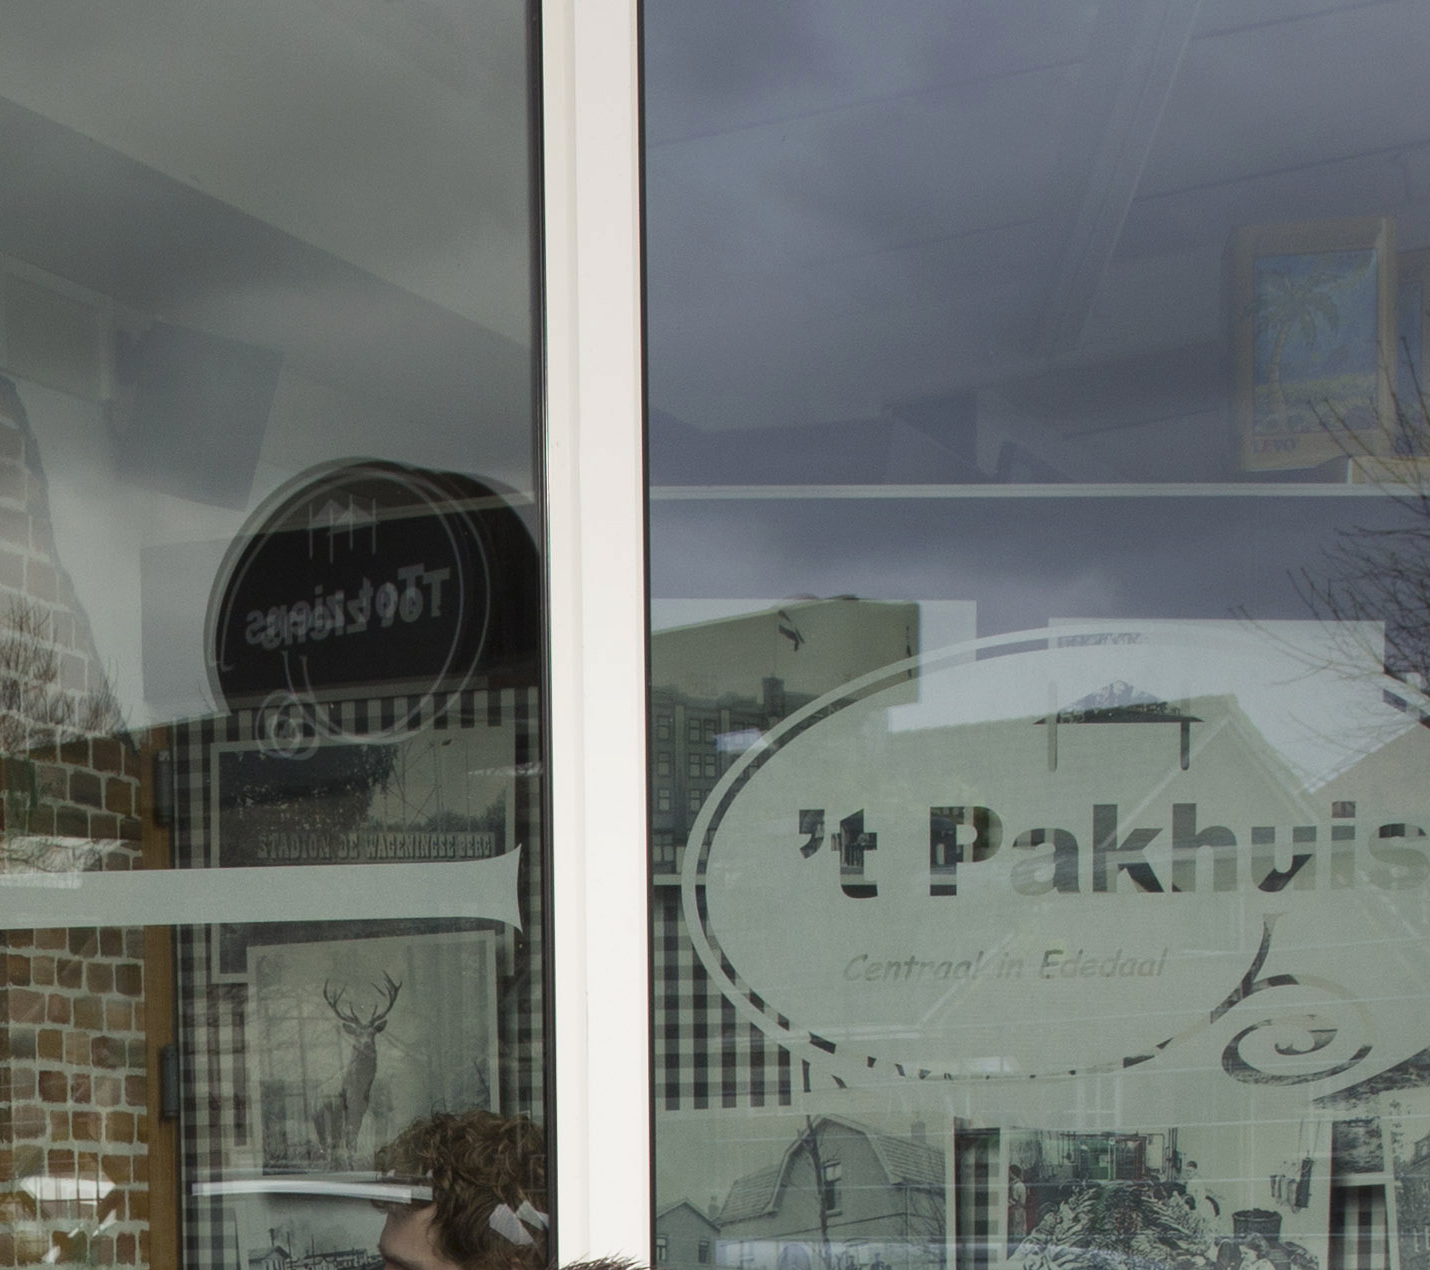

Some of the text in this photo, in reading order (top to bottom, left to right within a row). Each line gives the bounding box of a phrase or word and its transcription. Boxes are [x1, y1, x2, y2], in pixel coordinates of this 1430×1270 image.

[797, 799, 1430, 900] 't Pakhuis
[842, 947, 1168, 983] Centraal in Ededaal
